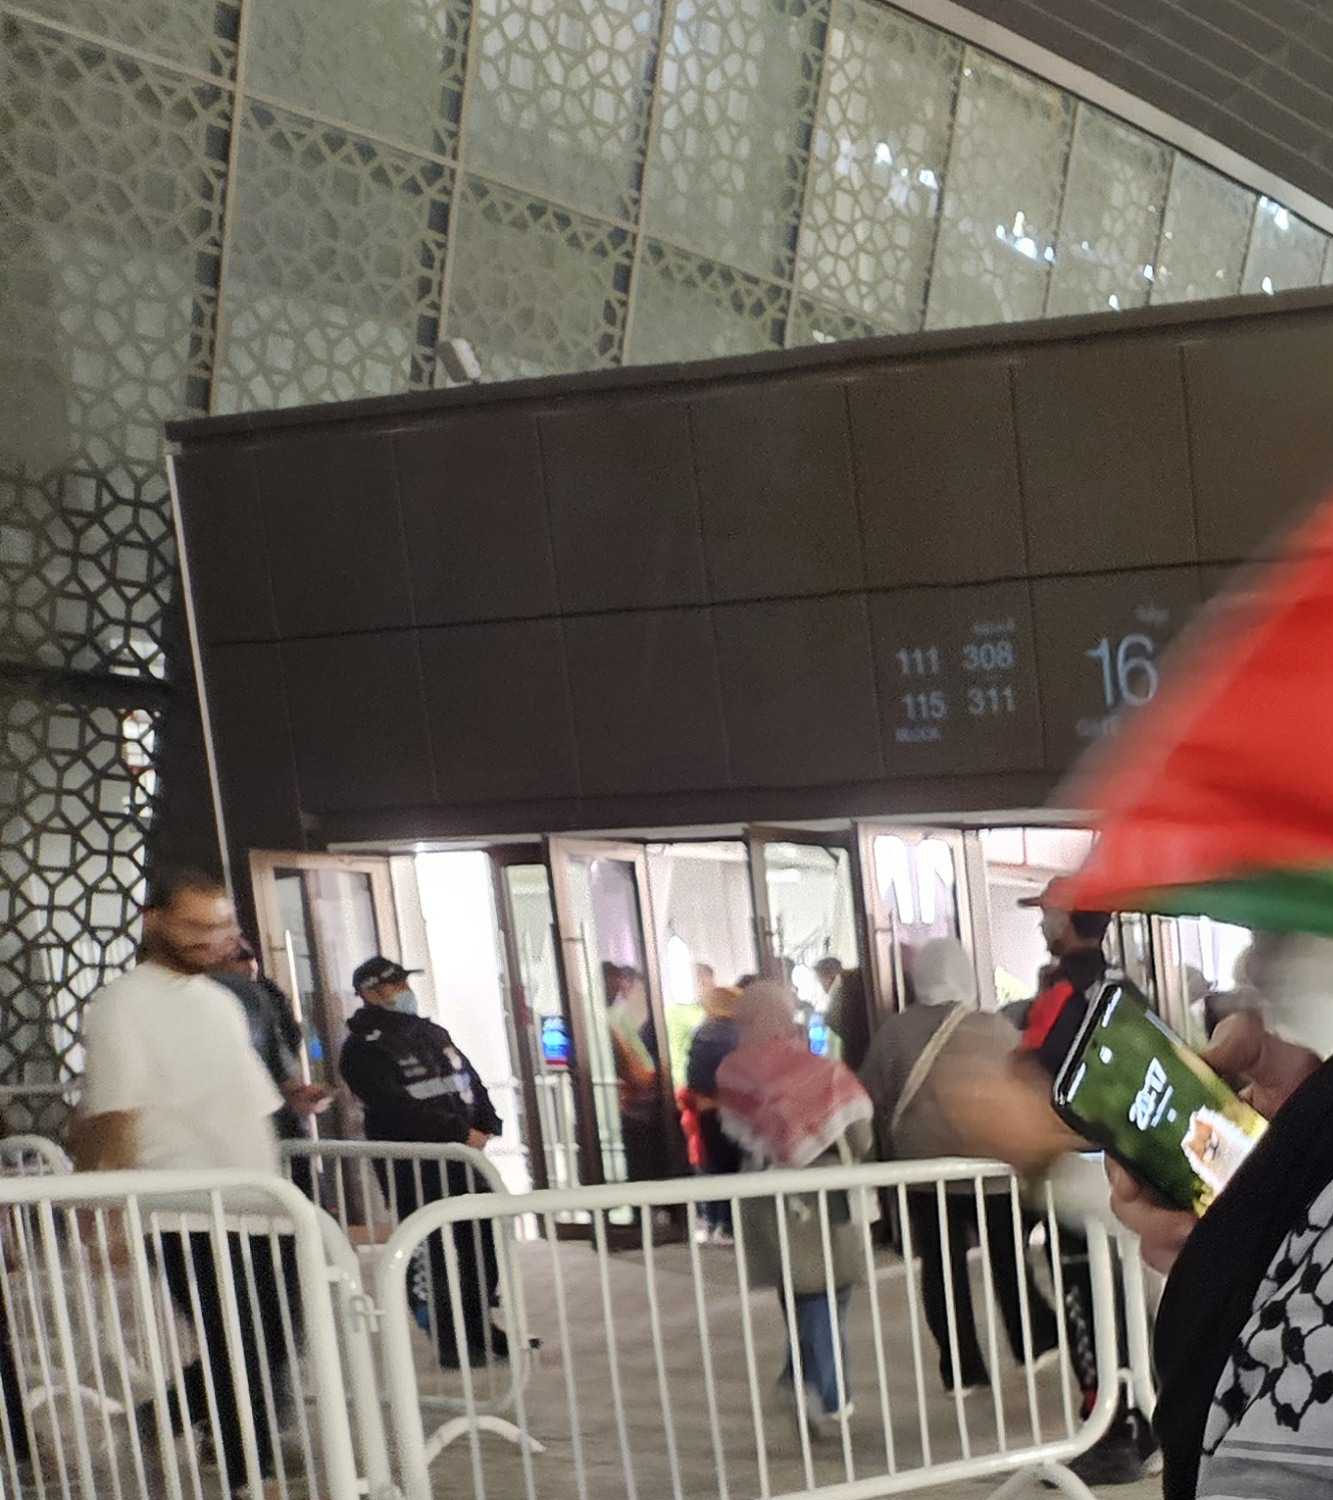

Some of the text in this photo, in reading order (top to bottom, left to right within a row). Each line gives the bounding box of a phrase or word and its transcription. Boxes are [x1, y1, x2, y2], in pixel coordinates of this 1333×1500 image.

[895, 646, 940, 675] 111
[962, 640, 1015, 671] 308
[1085, 633, 1159, 706] 16
[900, 690, 948, 720] 115
[967, 685, 1016, 715] 311
